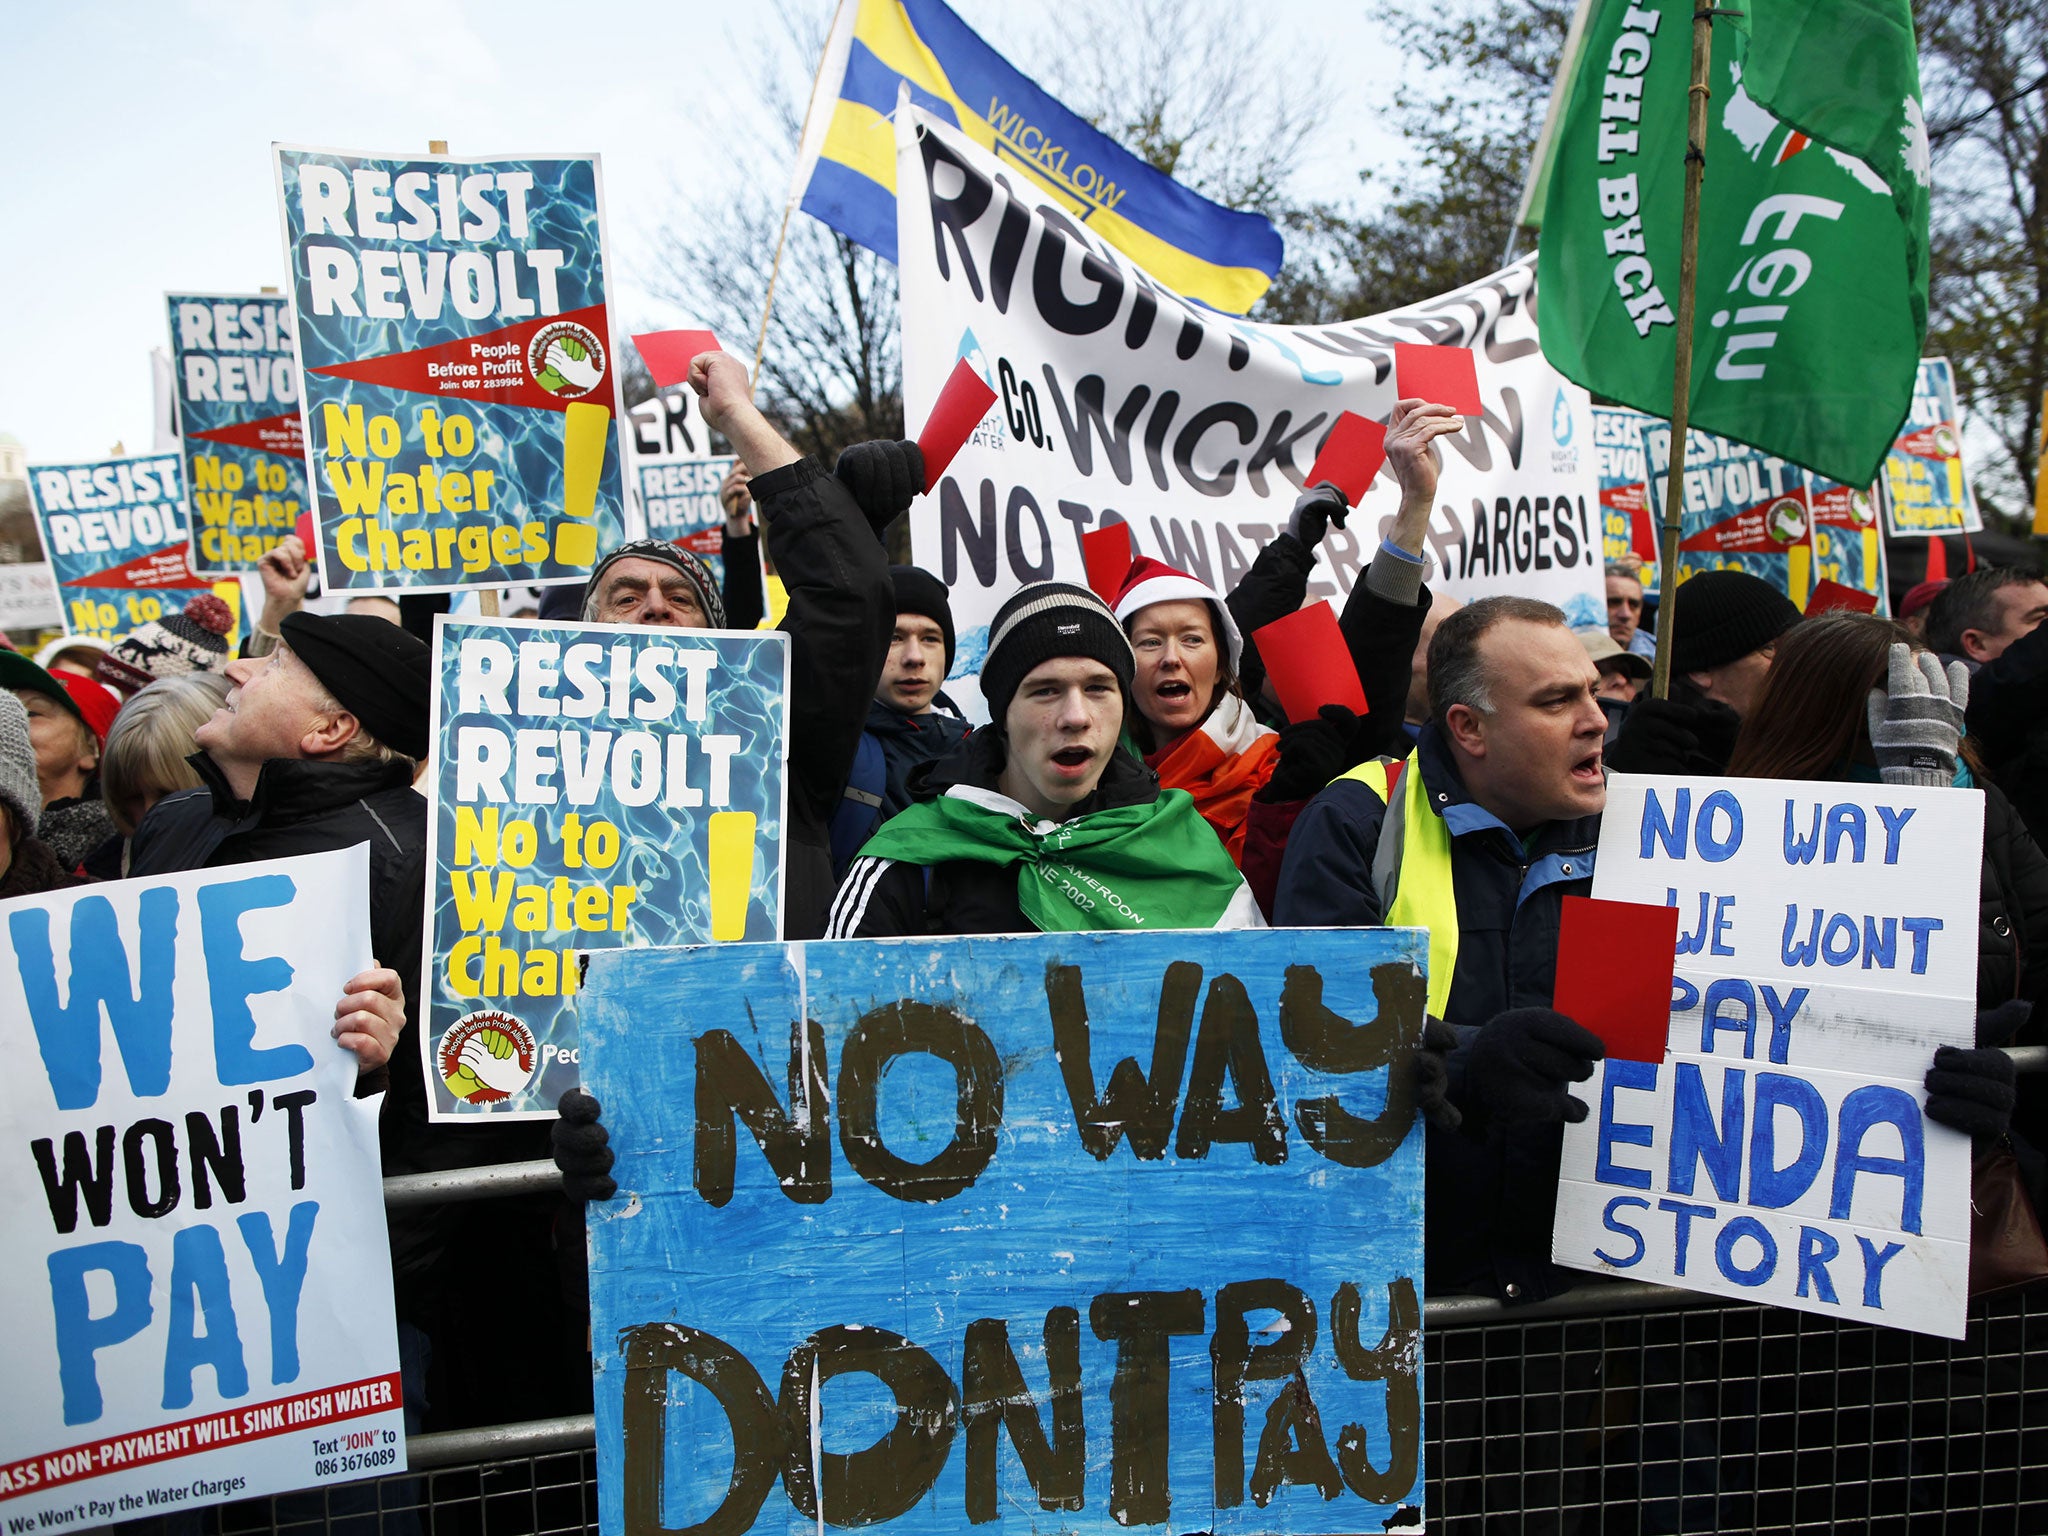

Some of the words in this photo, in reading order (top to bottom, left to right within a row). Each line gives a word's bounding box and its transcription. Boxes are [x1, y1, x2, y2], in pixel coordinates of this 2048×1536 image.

[986, 95, 1126, 211] WICKLOW
[299, 164, 534, 242] RESIST
[307, 246, 564, 320] REVOLT
[179, 303, 293, 352] RESIS
[470, 342, 520, 358] People
[184, 355, 298, 404] REVO
[427, 361, 478, 377] Before
[482, 359, 523, 376] Profit
[439, 380, 460, 390] Join:
[462, 379, 480, 389] 087
[323, 403, 402, 459] No
[420, 408, 475, 458] to
[966, 431, 1006, 452] ATER
[1042, 362, 1524, 498] WICKW
[37, 458, 179, 512] RESIST
[194, 455, 244, 491] No
[255, 459, 288, 493] to
[326, 461, 494, 515] Water
[644, 462, 730, 498] RESIST
[48, 500, 189, 555] REVOL
[196, 492, 298, 527] Water
[649, 495, 726, 528] REVO
[939, 475, 1054, 588] NO
[201, 528, 290, 563] Char
[70, 598, 119, 632] No
[126, 595, 162, 625] to
[459, 638, 718, 721] RESIST
[456, 726, 741, 807] REVOLT
[454, 805, 538, 868] No
[560, 812, 620, 869] to
[1639, 787, 1744, 863] NO
[1783, 799, 1917, 866] WAY
[450, 871, 637, 932] Water
[1058, 879, 1096, 913] 2002
[1060, 860, 1145, 924] AMEROON
[448, 936, 580, 997] Char
[1781, 903, 1943, 975] WONT
[9, 874, 315, 1111] WE
[448, 1031, 466, 1056] People
[465, 1019, 491, 1034] Before
[491, 1019, 512, 1032] Profit
[511, 1029, 528, 1056] Alliance
[542, 1044, 581, 1065] Peo
[690, 998, 1005, 1208] NO
[1044, 960, 1429, 1168] WAY
[30, 1088, 317, 1234] WON'T
[1595, 1057, 1926, 1237] ENDA
[1593, 1195, 1906, 1310] STORY
[47, 1200, 320, 1427] PAY
[0, 1462, 41, 1493] ASS
[44, 1425, 191, 1481] NON-PAYMENT
[193, 1415, 241, 1446] WILL
[243, 1403, 285, 1434] SINK
[287, 1393, 332, 1424] IRISH
[334, 1381, 393, 1413] WATER
[313, 1439, 338, 1456] Text
[382, 1430, 396, 1444] to
[315, 1458, 338, 1476] 086
[341, 1447, 396, 1472] 3676089
[8, 1517, 35, 1535] We
[89, 1501, 115, 1518] Pay
[119, 1493, 143, 1511] the
[146, 1487, 189, 1505] Water
[192, 1476, 246, 1497] Charges
